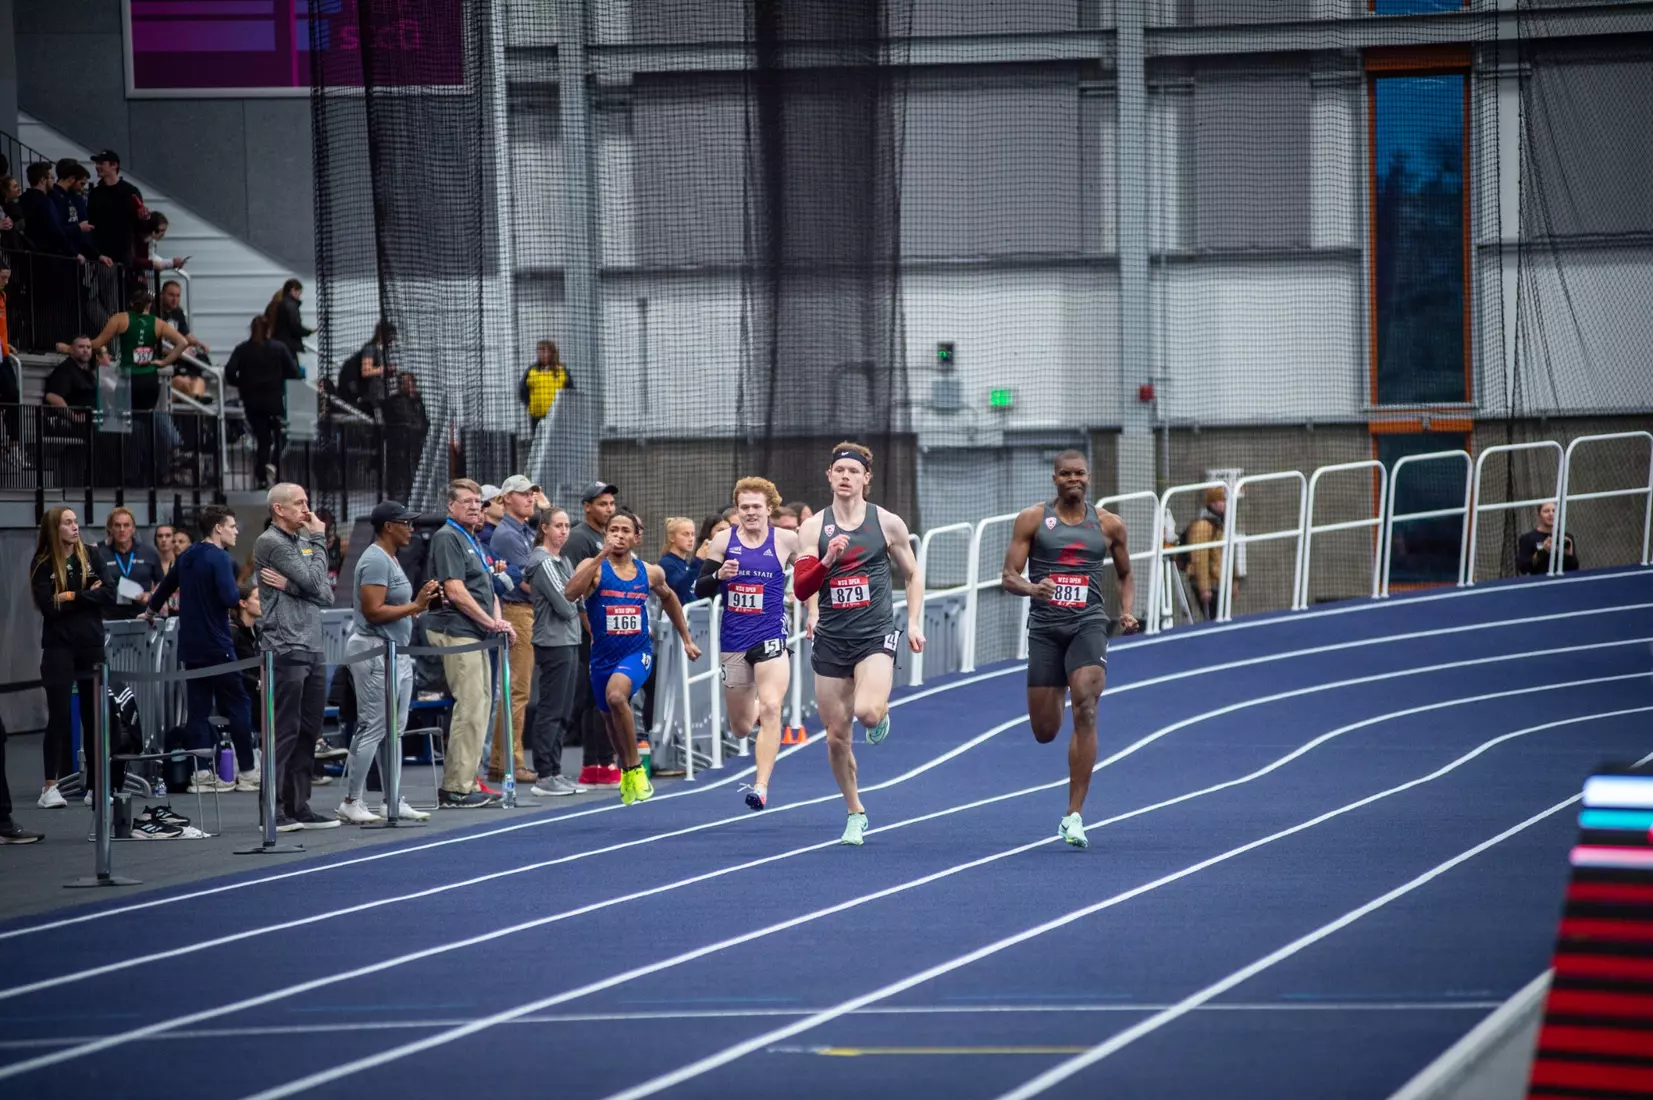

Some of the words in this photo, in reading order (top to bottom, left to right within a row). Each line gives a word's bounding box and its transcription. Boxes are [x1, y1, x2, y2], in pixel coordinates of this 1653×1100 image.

[753, 570, 773, 578] STATE
[733, 593, 756, 608] 911
[836, 586, 864, 603] 879
[1054, 585, 1080, 601] 881
[613, 615, 637, 630] 166
[767, 640, 777, 652] 5
[887, 635, 896, 649] 4
